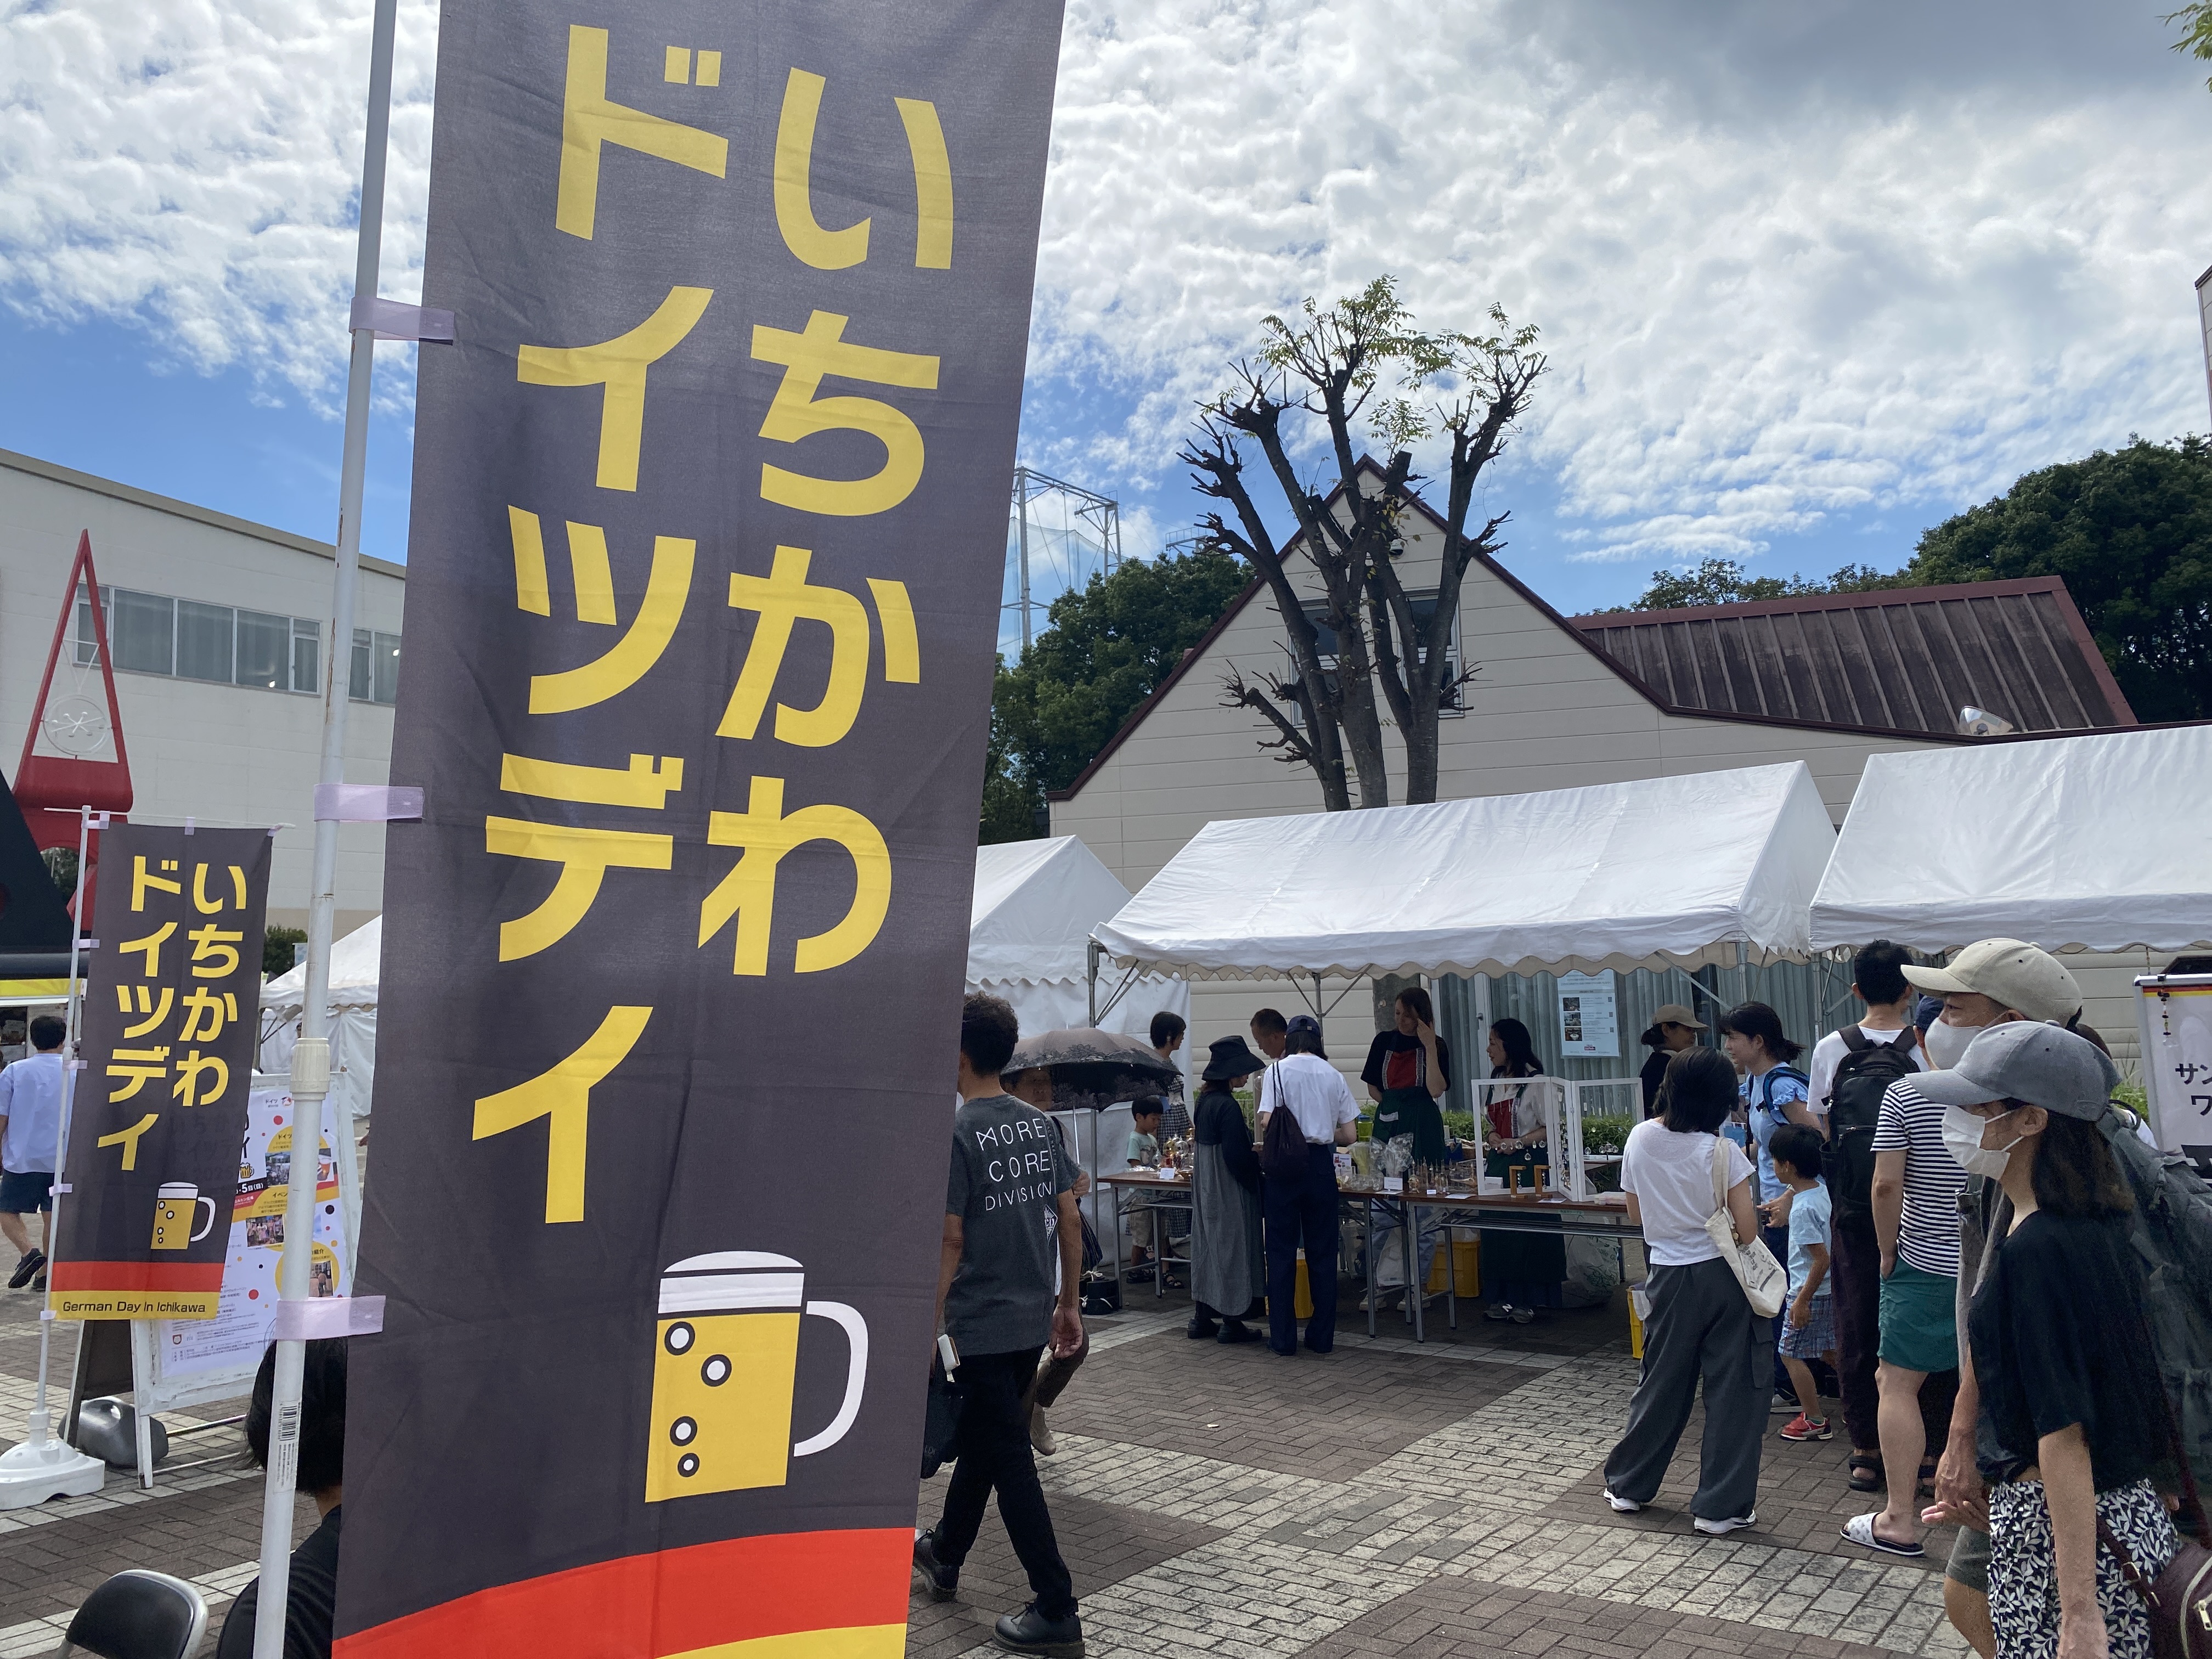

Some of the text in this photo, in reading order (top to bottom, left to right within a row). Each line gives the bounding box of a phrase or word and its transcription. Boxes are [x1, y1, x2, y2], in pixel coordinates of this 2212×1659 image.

[698, 71, 952, 976] いちかわ
[472, 27, 726, 1223] ドイツデイ
[99, 855, 181, 1169] ドイツデイ
[172, 863, 246, 1106] いちかわ
[976, 1118, 1046, 1151] MORE
[985, 1181, 1052, 1211] DIVISION
[989, 1150, 1051, 1182] CORE
[63, 1301, 112, 1312] German
[116, 1301, 142, 1313] Day
[156, 1301, 206, 1313] Ichikawa
